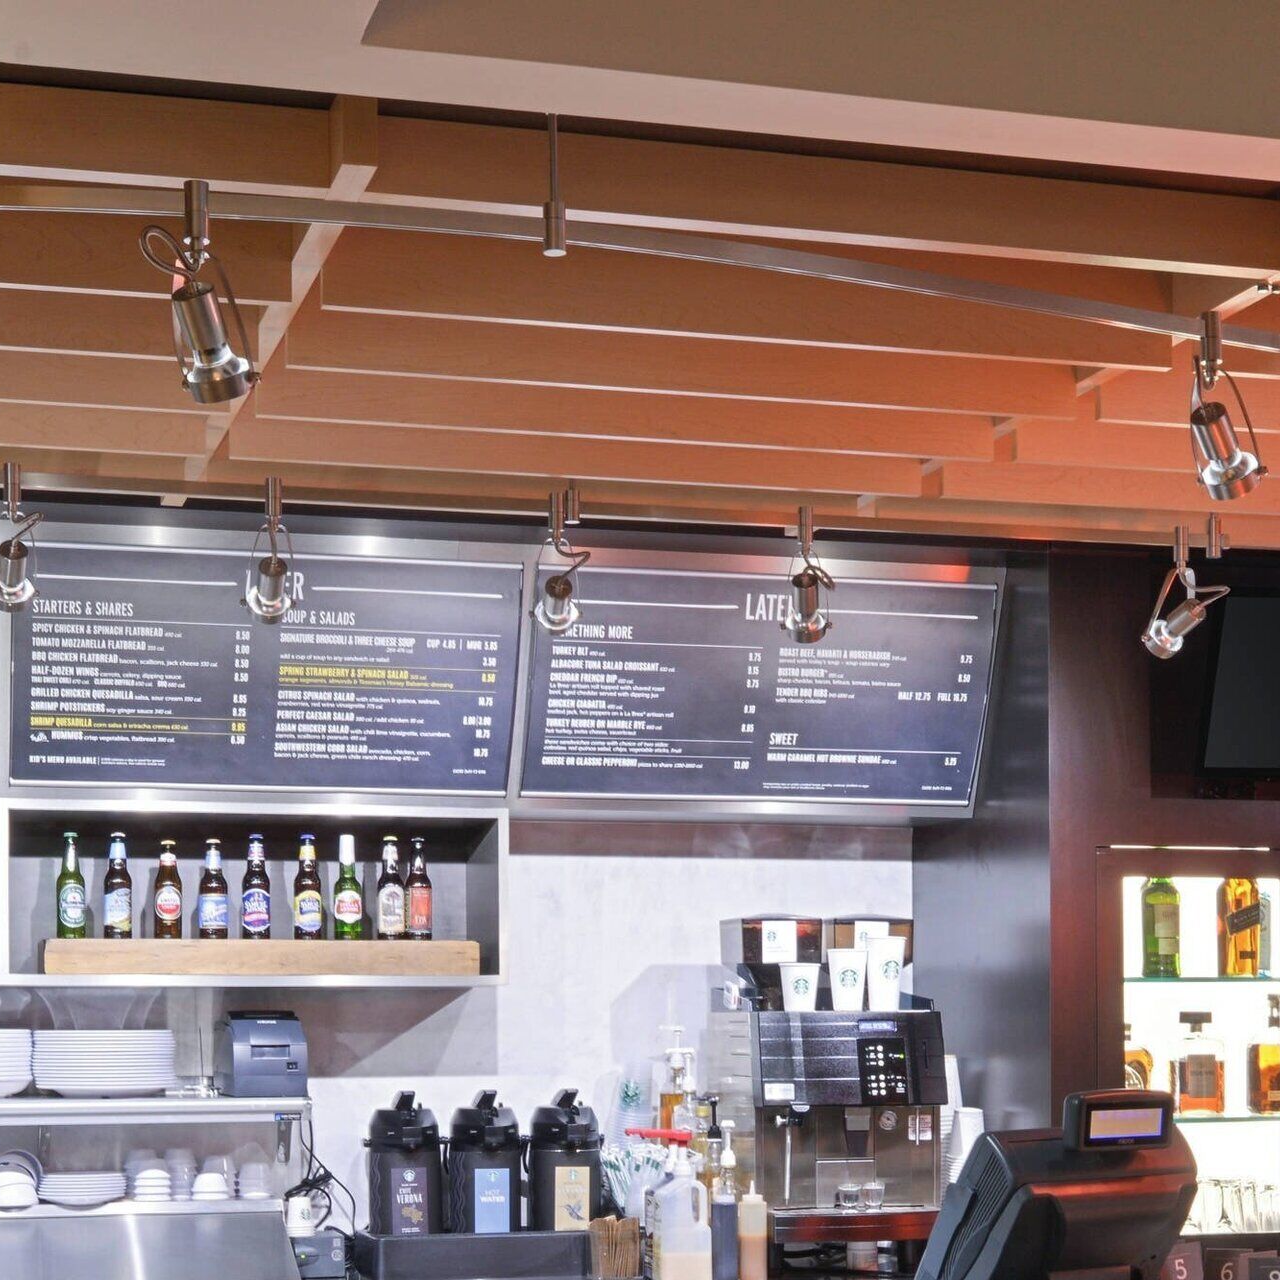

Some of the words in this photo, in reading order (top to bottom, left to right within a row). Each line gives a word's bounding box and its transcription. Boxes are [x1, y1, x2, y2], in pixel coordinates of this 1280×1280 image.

[33, 600, 81, 615] STARTERS
[85, 600, 92, 615] &
[96, 601, 134, 617] SHARES
[283, 611, 307, 625] SOUP
[310, 611, 316, 625] &
[320, 612, 355, 626] SALADS
[32, 622, 53, 634] SPICY
[55, 623, 85, 635] CHICKEN
[93, 624, 124, 636] SPINACH
[125, 626, 163, 637] FLATBREAD
[608, 626, 633, 640] MORE
[32, 637, 60, 648] TOMATO
[62, 638, 106, 650] MOZZARELLA
[108, 639, 146, 650] FLATBREAD
[898, 691, 914, 701] HALF
[937, 692, 952, 702] FULL
[770, 733, 798, 746] SWEET
[1176, 1258, 1187, 1280] 5
